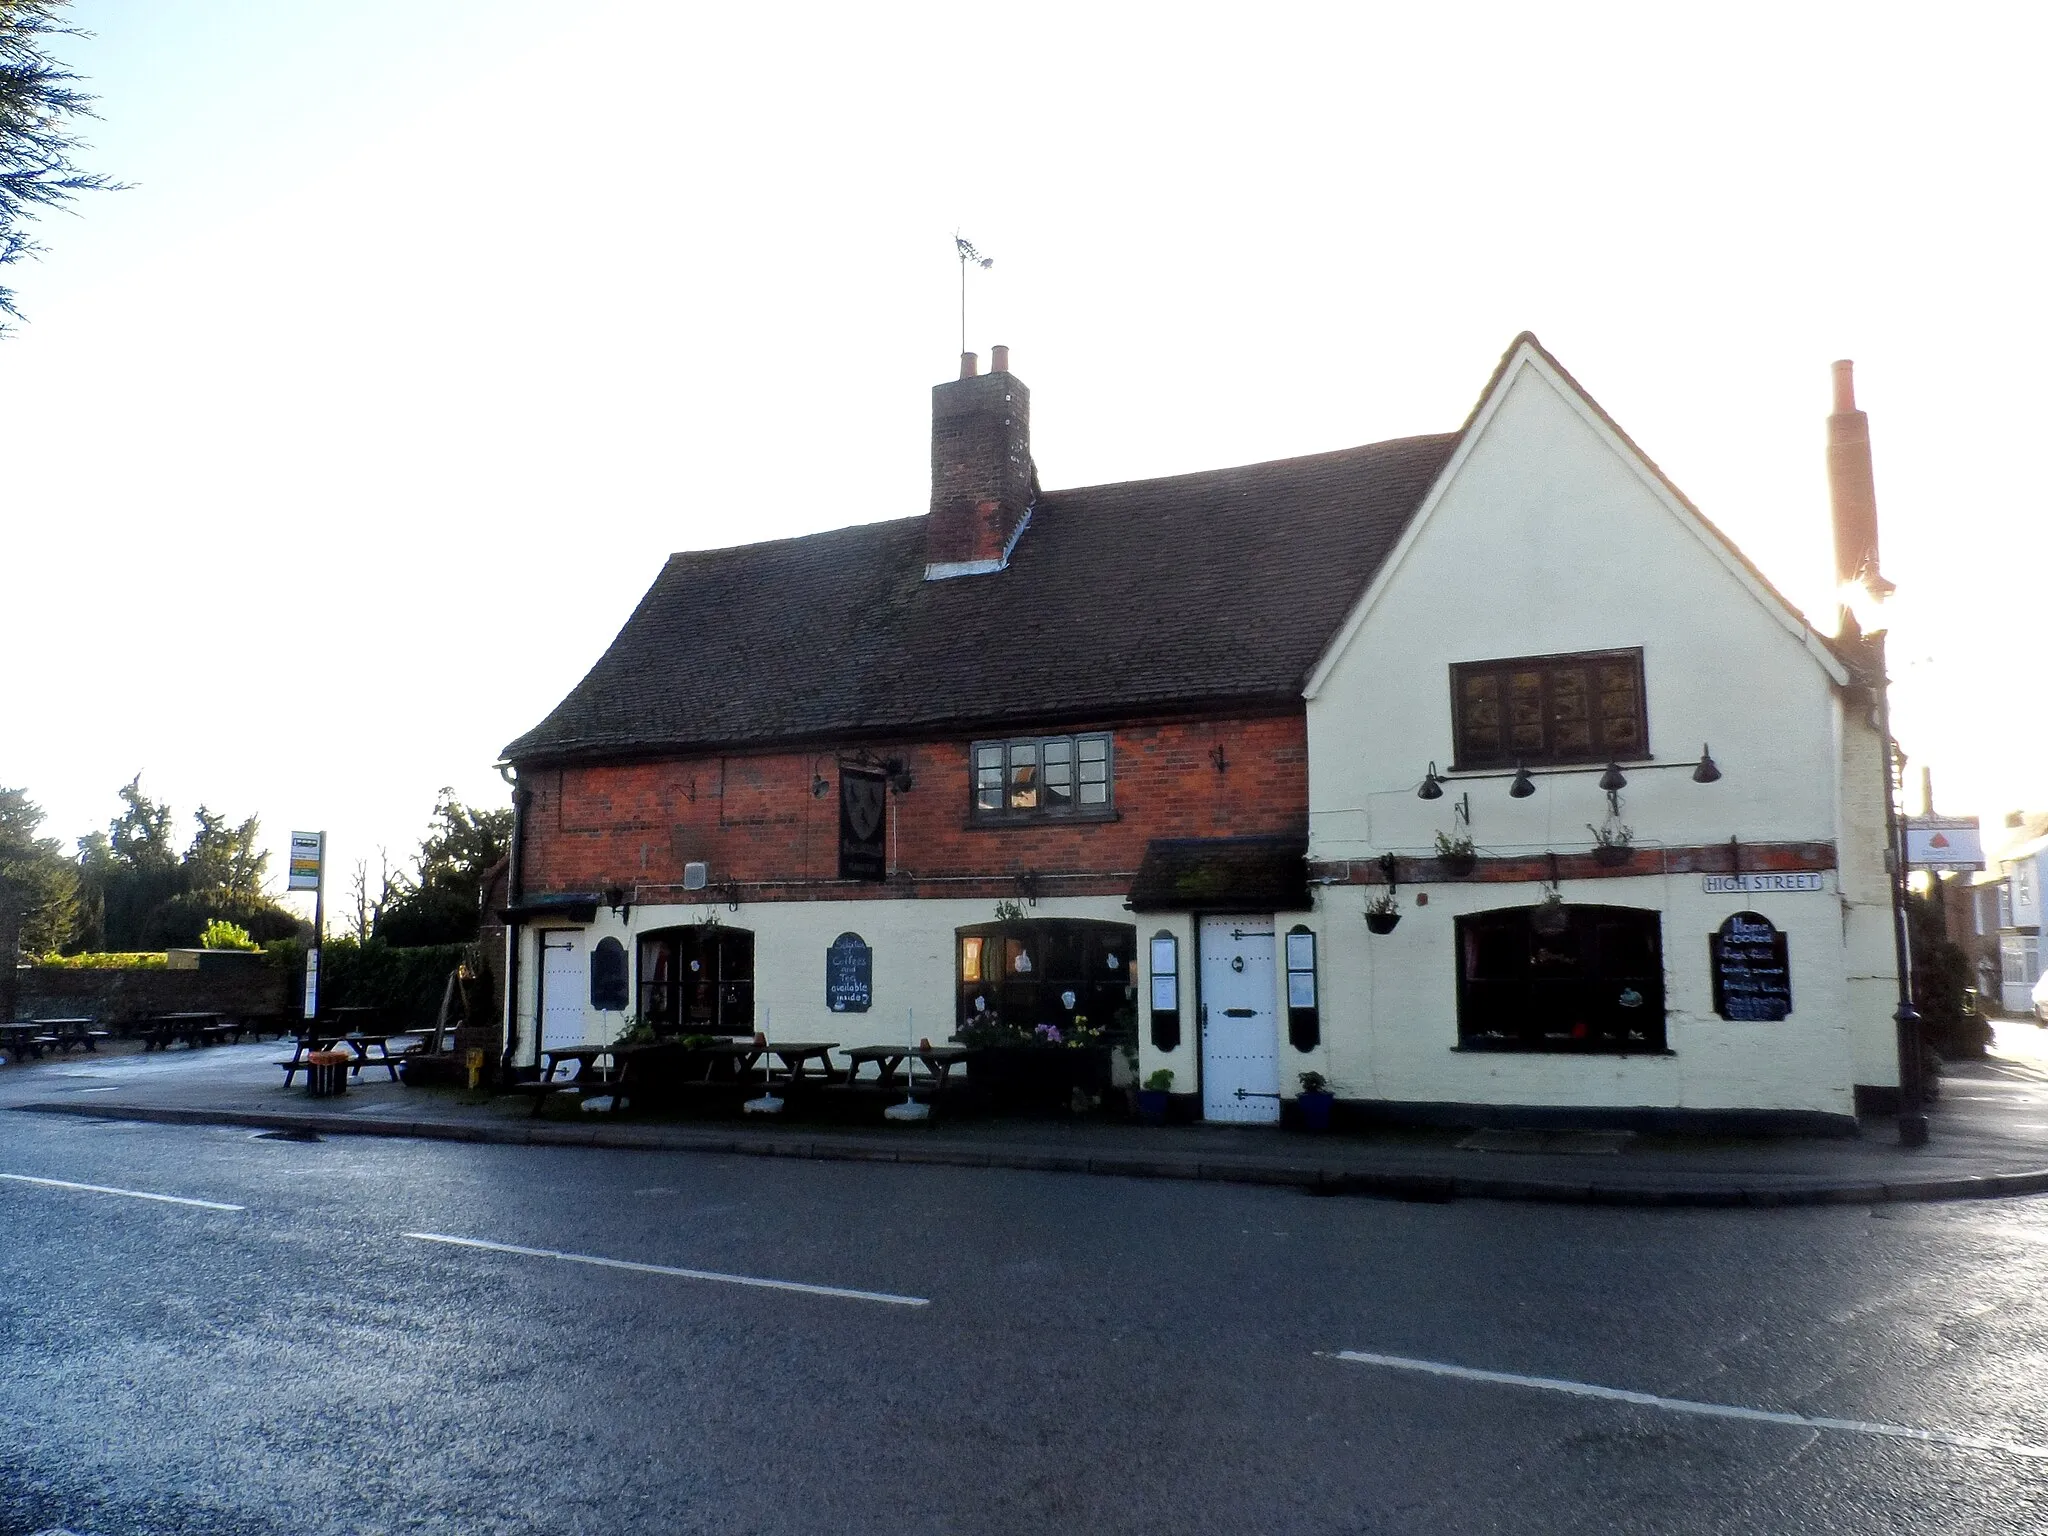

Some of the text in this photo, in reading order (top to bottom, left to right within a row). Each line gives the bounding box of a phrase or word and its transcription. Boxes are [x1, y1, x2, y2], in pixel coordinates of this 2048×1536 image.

[1707, 874, 1819, 891] HIGH STREET
[839, 973, 856, 982] Tea
[831, 982, 868, 992] available
